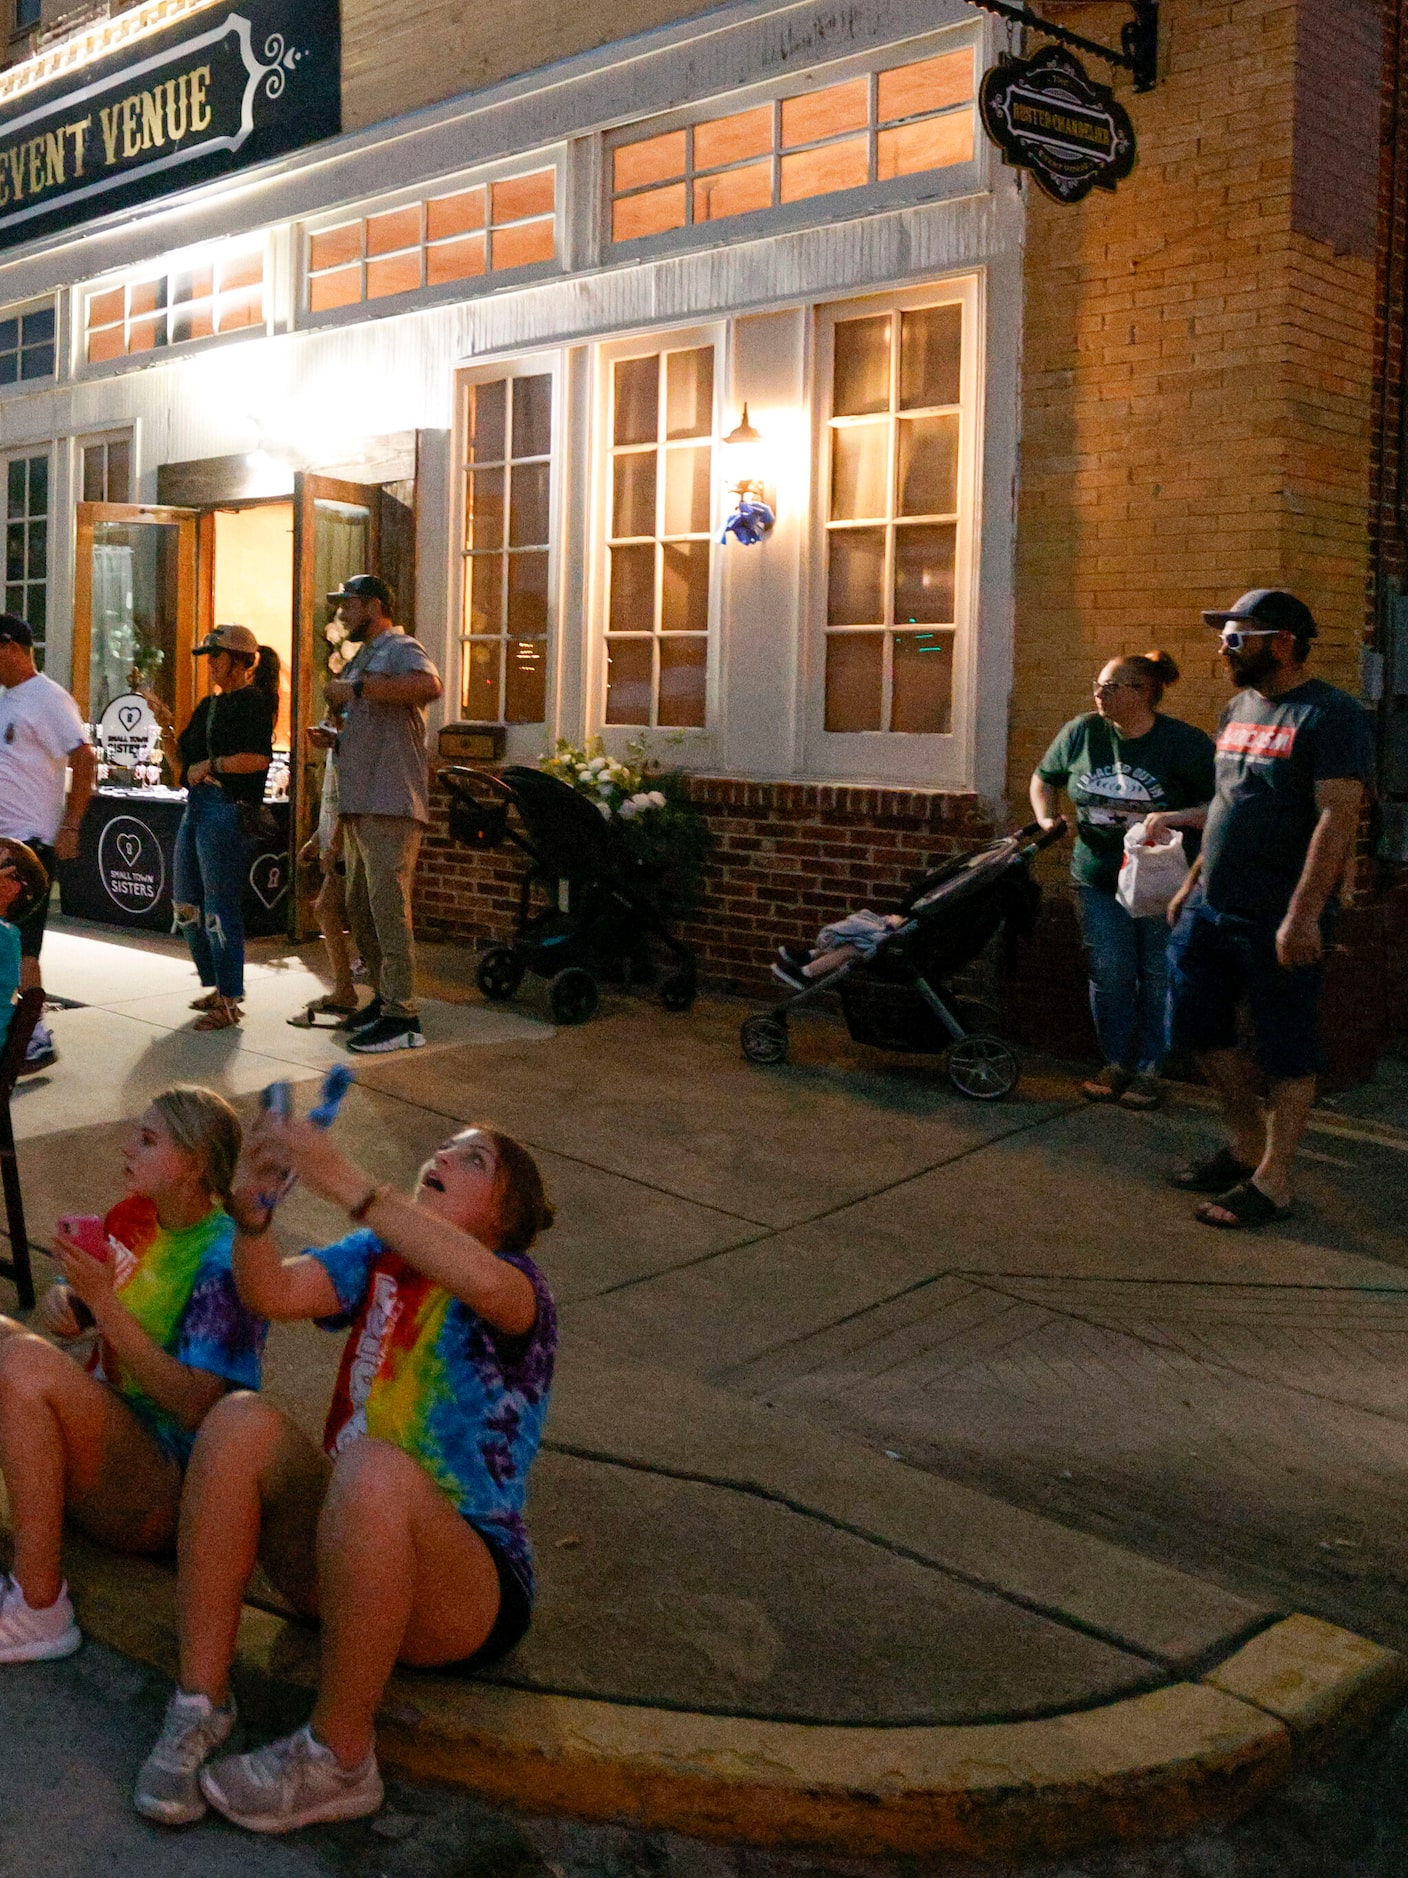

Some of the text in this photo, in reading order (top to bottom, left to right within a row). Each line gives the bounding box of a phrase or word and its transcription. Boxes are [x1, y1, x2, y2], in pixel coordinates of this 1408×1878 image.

[99, 64, 212, 166] VENUE
[107, 743, 148, 754] ISTE
[1079, 763, 1132, 785] BLACD
[110, 869, 154, 883] SMALL TOWN
[111, 879, 154, 898] SISTERS
